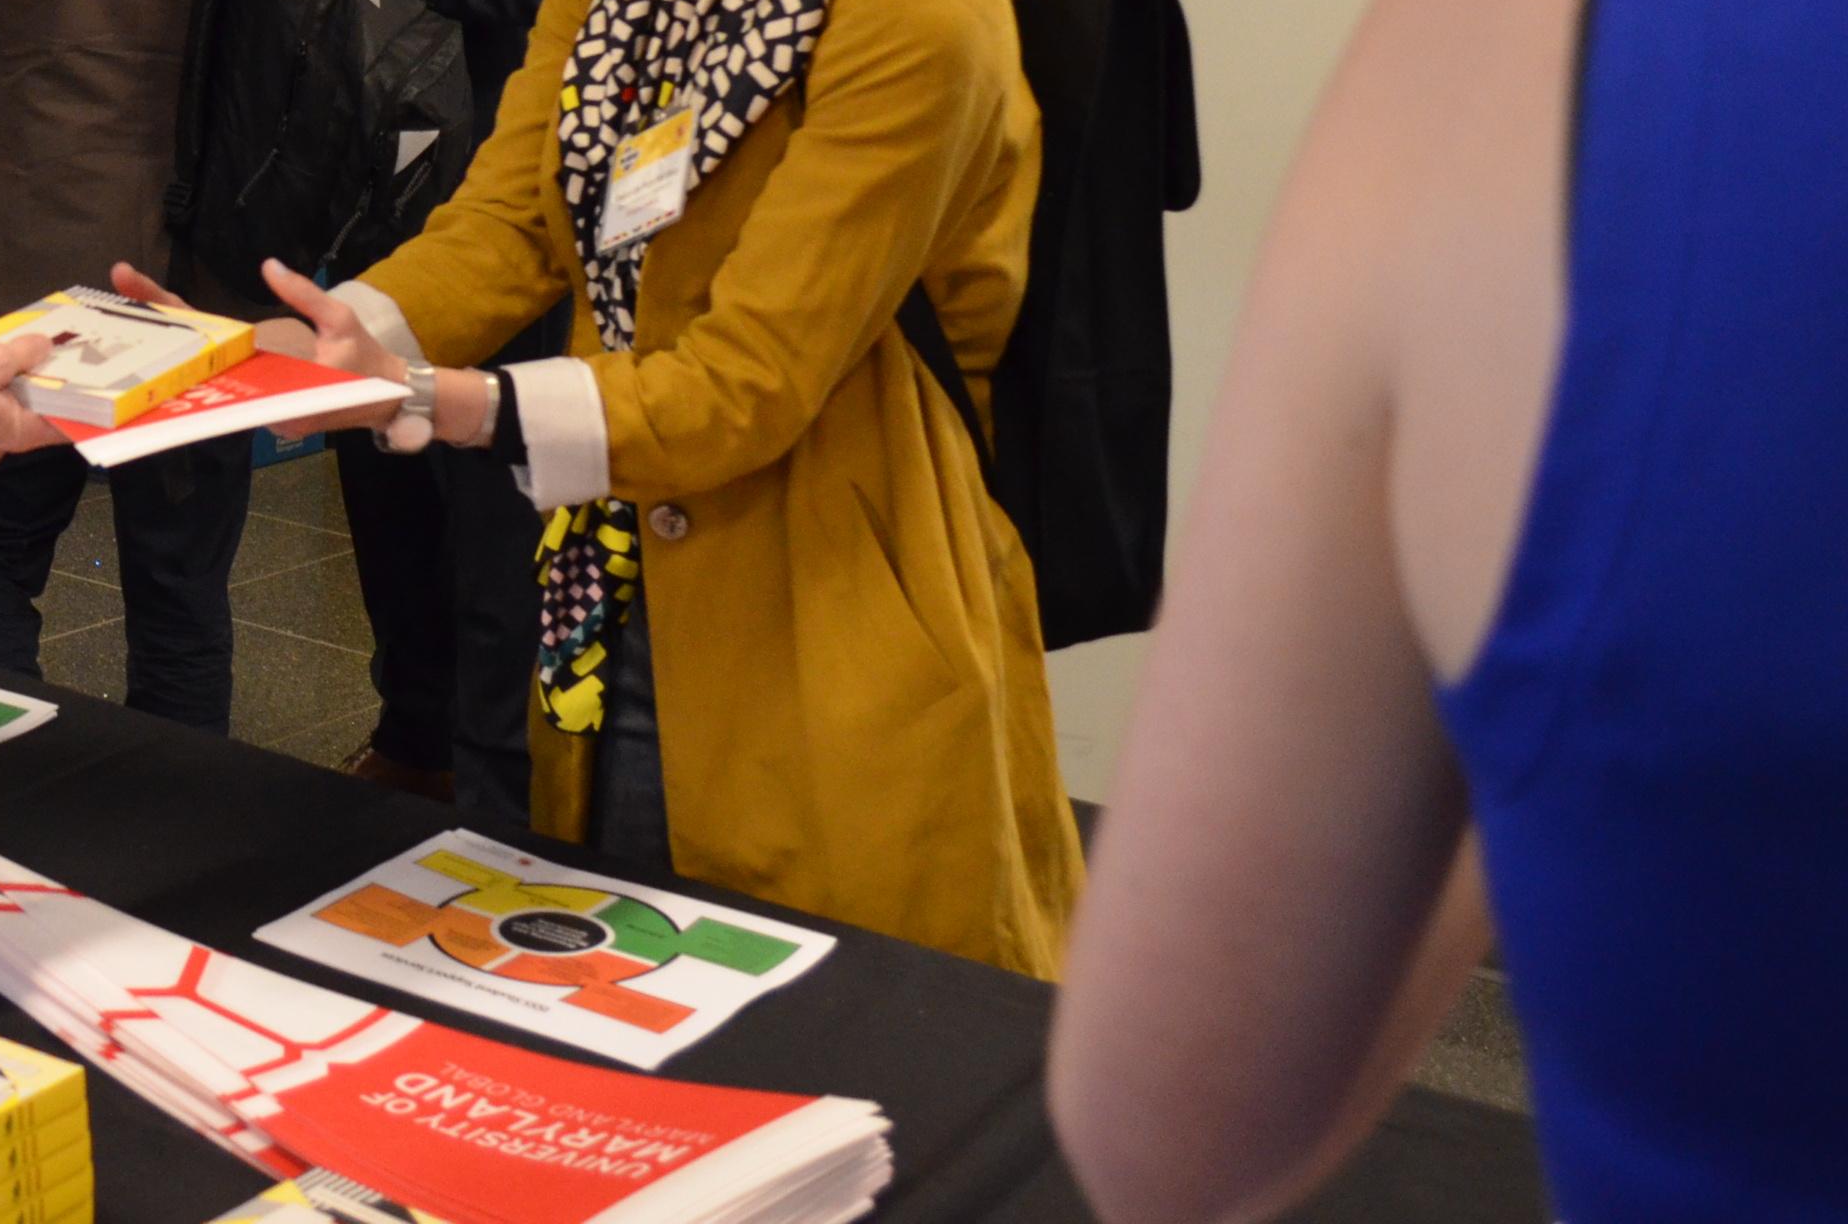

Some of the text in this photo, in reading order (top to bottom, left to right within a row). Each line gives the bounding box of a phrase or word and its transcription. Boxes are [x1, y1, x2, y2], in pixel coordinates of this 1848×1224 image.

[359, 1092, 653, 1179] UNIVERSITY OF
[393, 1072, 693, 1165] MARYLAND
[440, 1061, 717, 1145] MARYLAND GLOBAL
